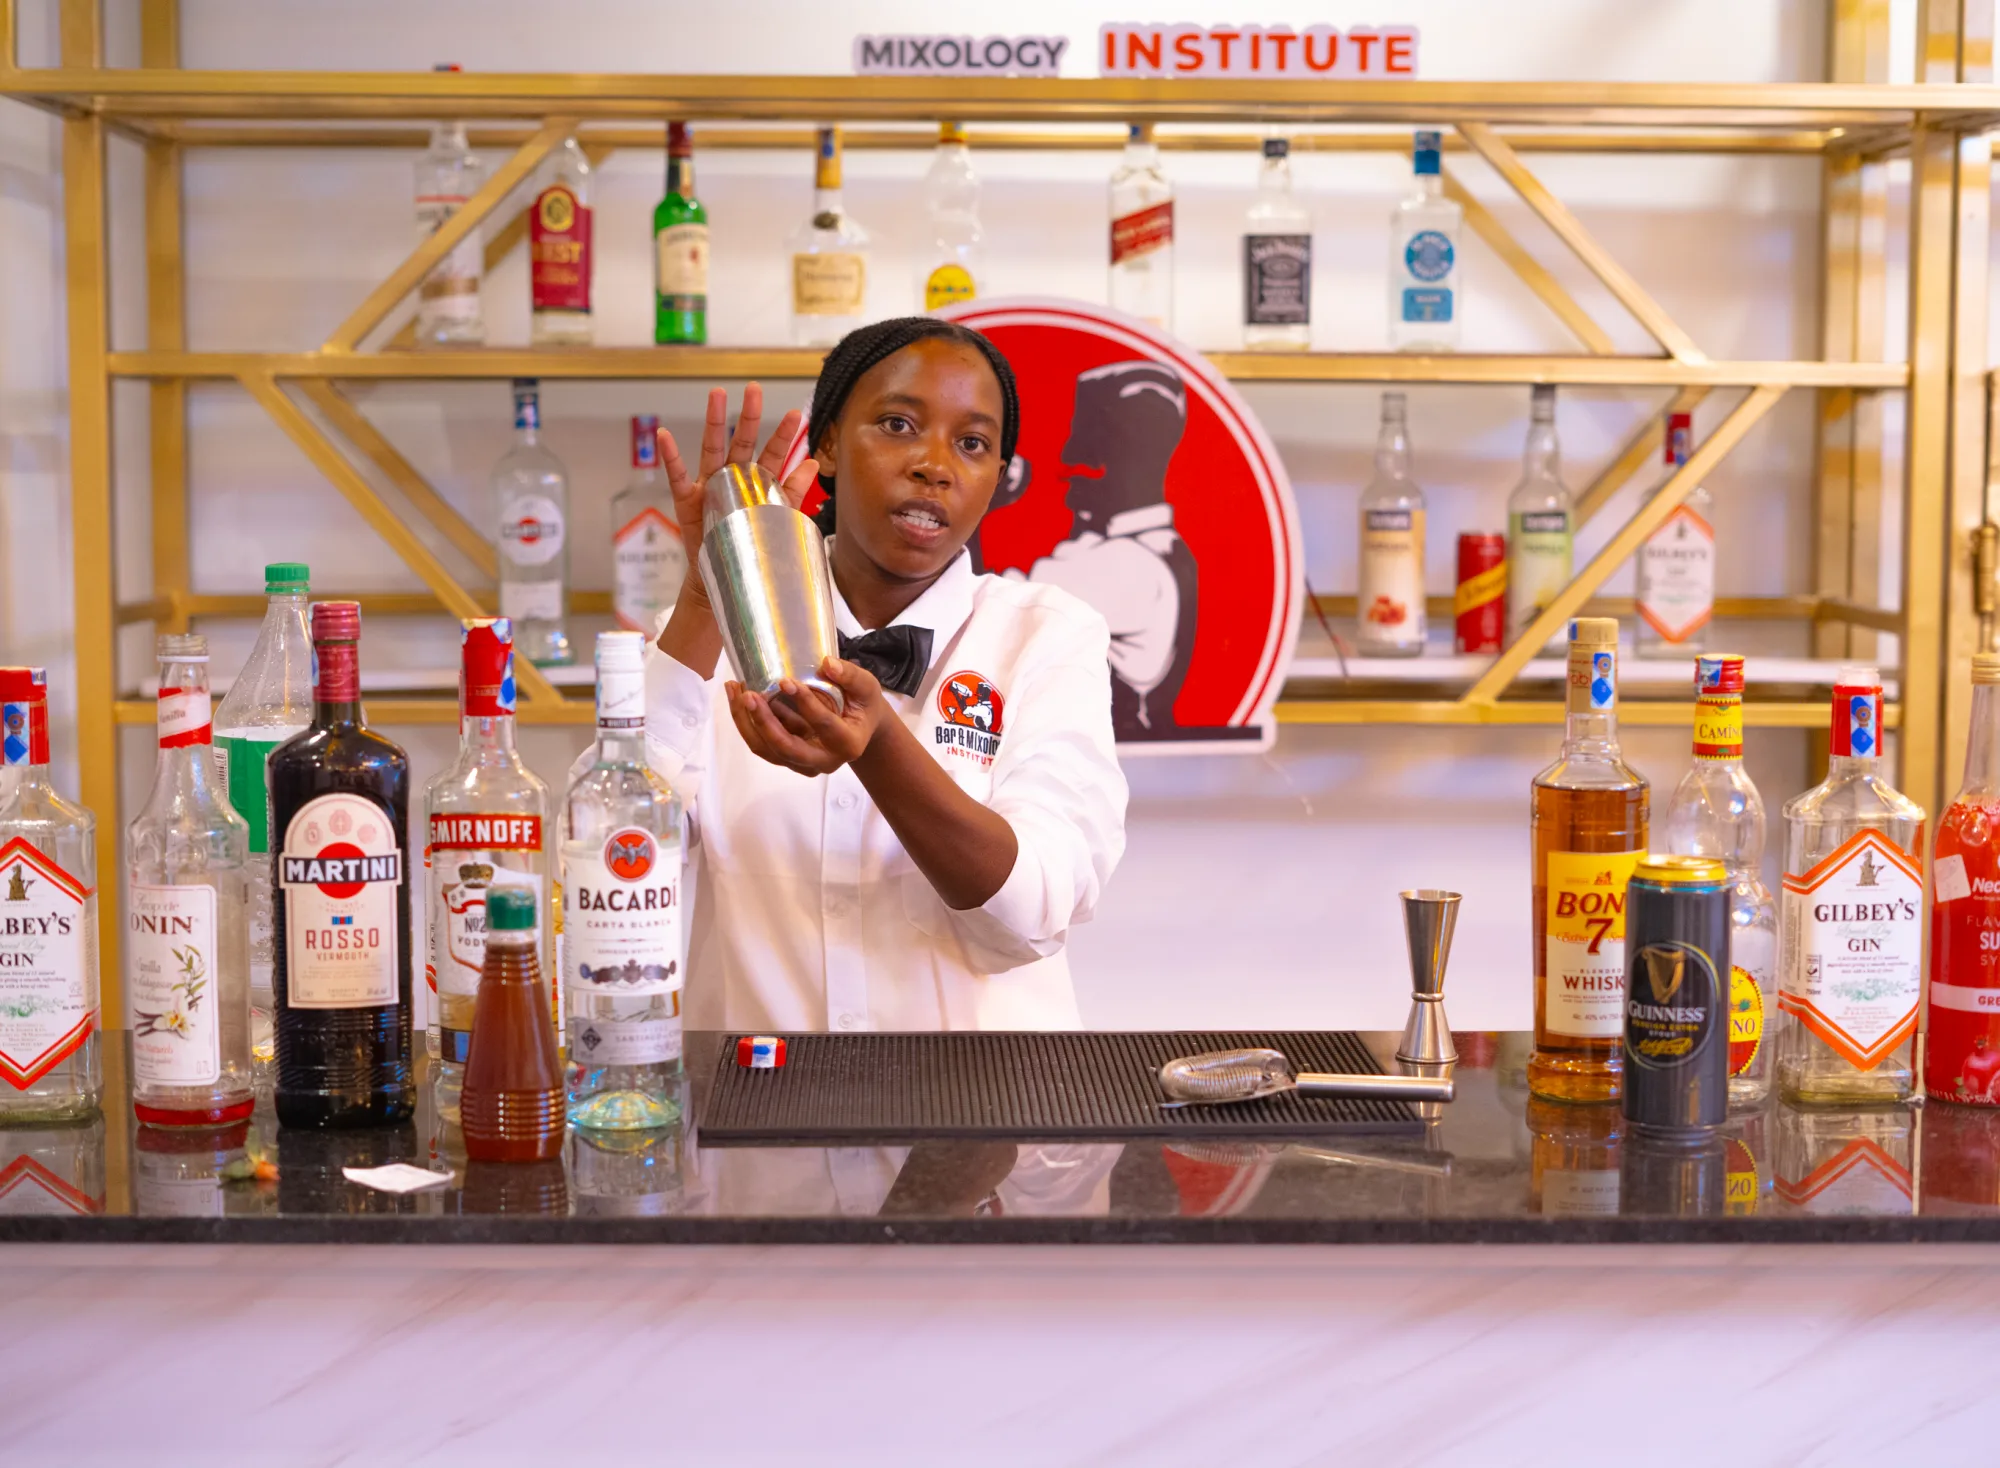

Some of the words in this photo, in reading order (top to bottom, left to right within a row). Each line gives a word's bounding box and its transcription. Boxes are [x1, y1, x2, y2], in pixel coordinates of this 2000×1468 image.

[861, 39, 1065, 69] MIXOLOGY
[1104, 32, 1414, 73] INSTITUTE
[935, 726, 957, 744] Bar
[958, 727, 965, 747] &
[286, 855, 395, 883] MARTINI
[1814, 897, 1915, 923] GILBEY'S
[305, 927, 380, 950] ROSSO
[1585, 917, 1614, 956] 7
[1847, 938, 1882, 953] GIN
[0, 952, 34, 968] GIN
[1628, 1000, 1707, 1023] GUINNESS
